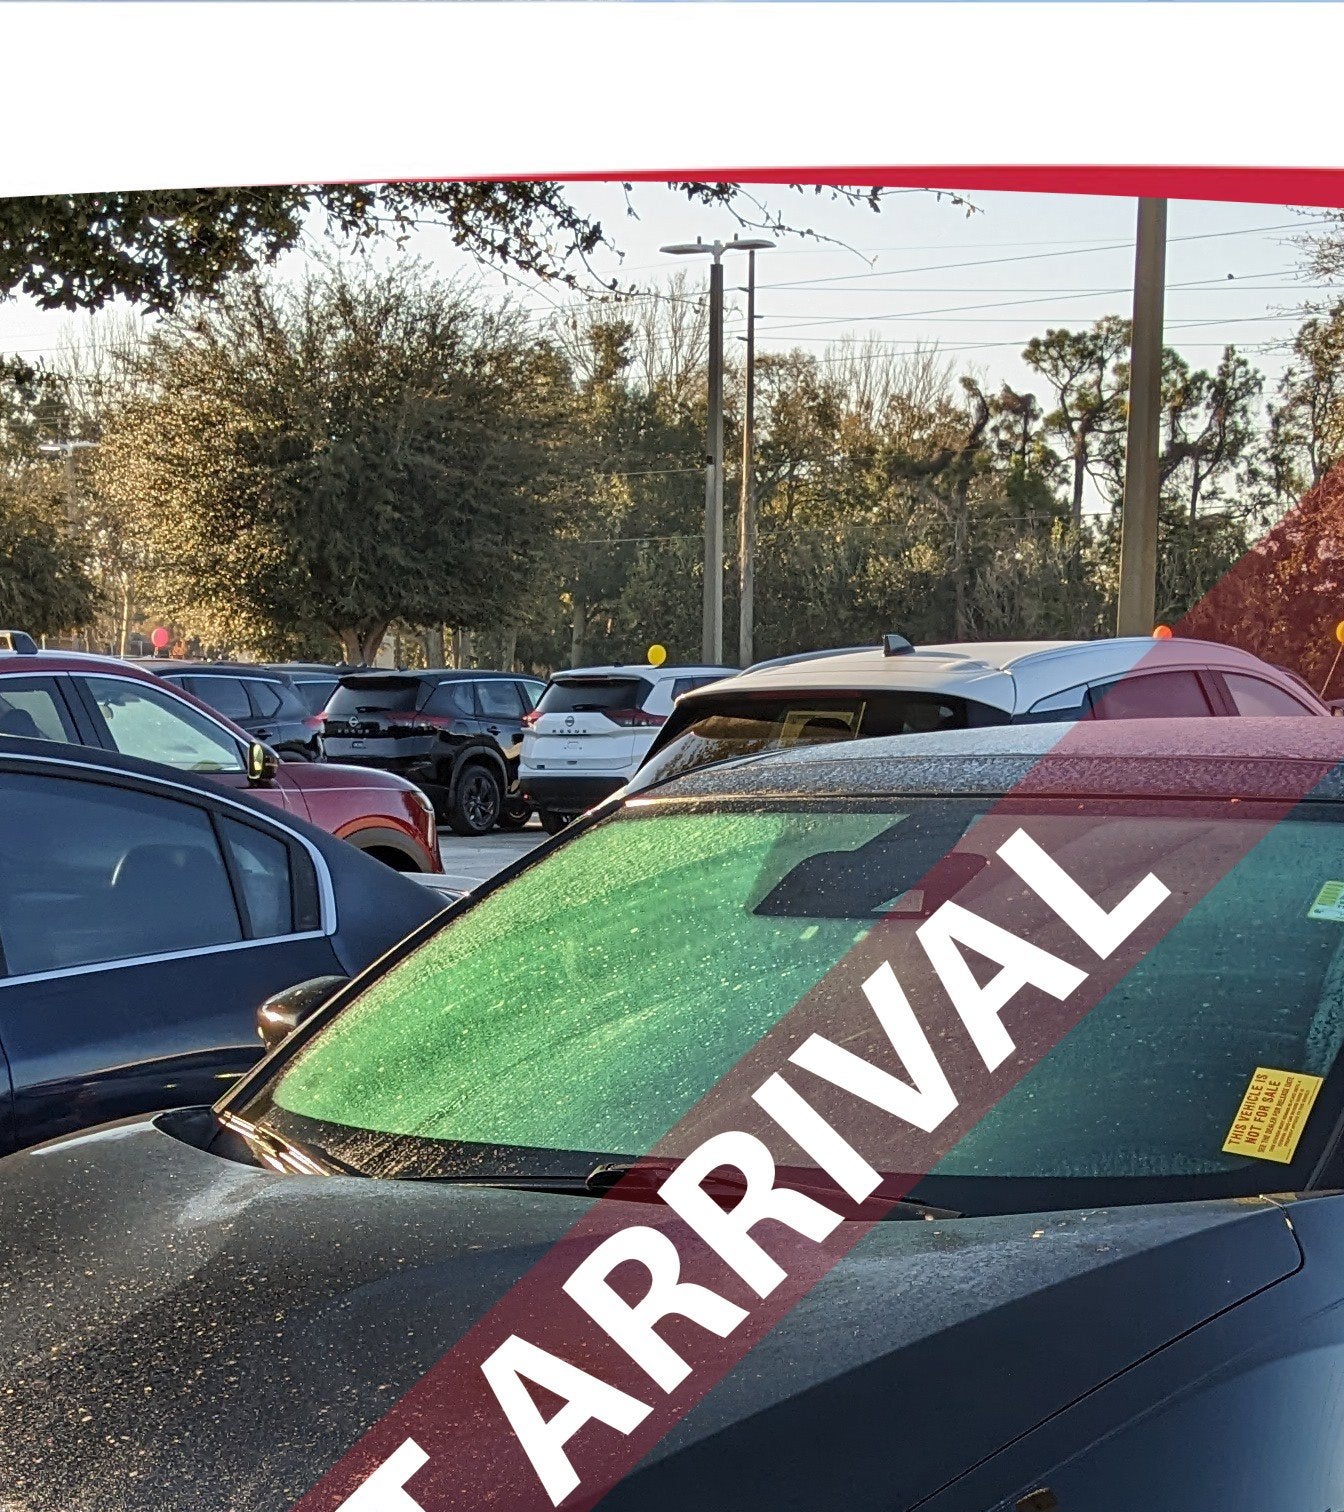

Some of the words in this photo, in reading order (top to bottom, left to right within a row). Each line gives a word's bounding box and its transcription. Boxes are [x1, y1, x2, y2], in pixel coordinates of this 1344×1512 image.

[1228, 1124, 1246, 1145] THIS
[1238, 1085, 1263, 1121] VEHICLE
[1255, 1073, 1268, 1083] IS
[1244, 1124, 1262, 1144] NOT
[1254, 1105, 1270, 1123] FOR
[1262, 1080, 1281, 1103] SALE
